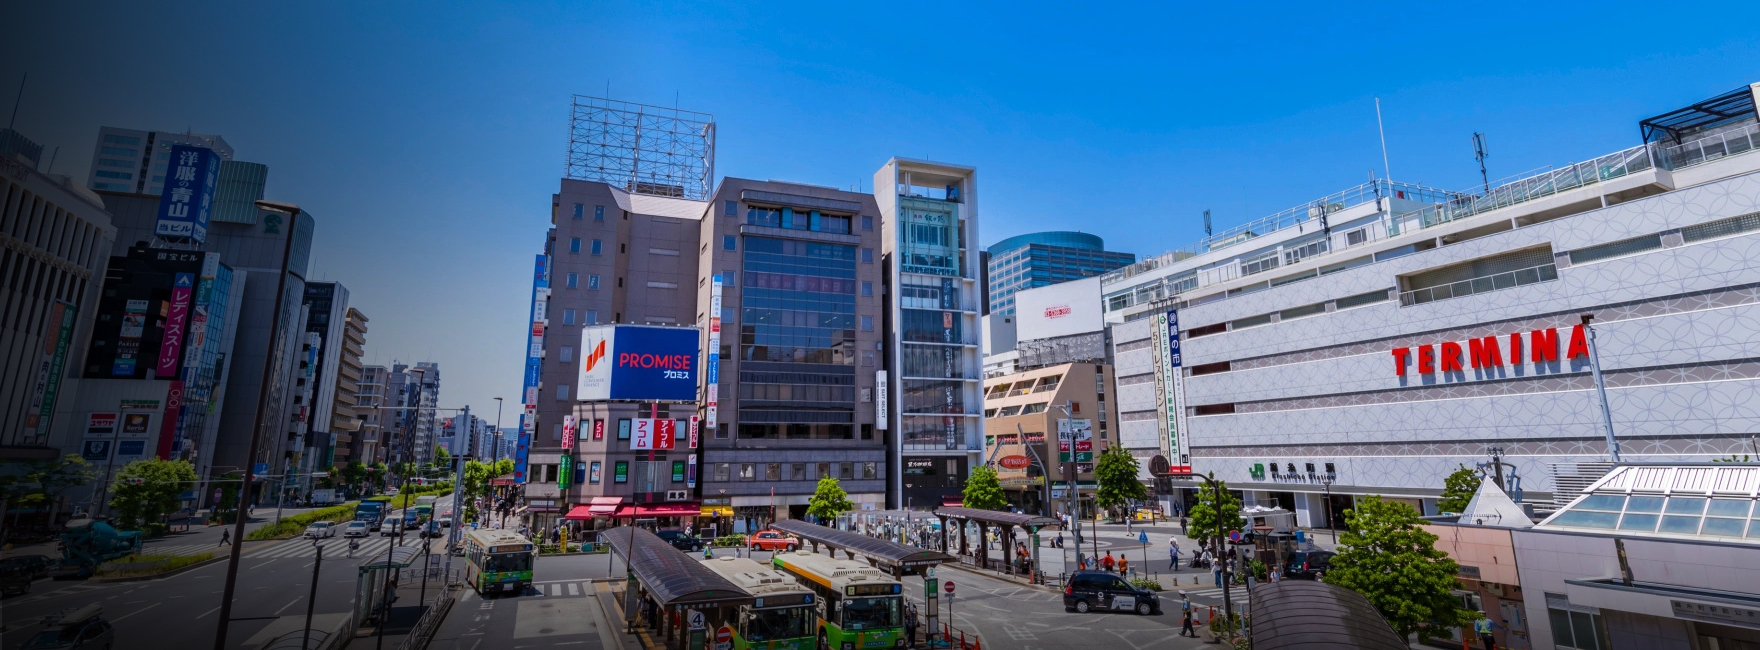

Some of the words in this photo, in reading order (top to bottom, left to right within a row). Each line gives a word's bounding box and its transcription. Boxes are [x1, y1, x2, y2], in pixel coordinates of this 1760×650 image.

[168, 150, 199, 218] 洋服の青山
[199, 156, 217, 224] 洋服の青山
[158, 223, 191, 232] 当ビル
[157, 252, 198, 262] 国宝ビル
[162, 290, 192, 369] レディススーツ
[1169, 323, 1180, 365] 錦の市
[1391, 324, 1590, 376] TERMINA
[619, 352, 691, 370] PROMISE
[663, 369, 690, 379] プロミス
[595, 421, 603, 439] アコム
[637, 420, 648, 448] アコム
[659, 420, 669, 448] アイフル
[1249, 463, 1265, 478] JR
[692, 613, 702, 625] 4
[1674, 602, 1756, 618] 錦糸町駅前公衆
